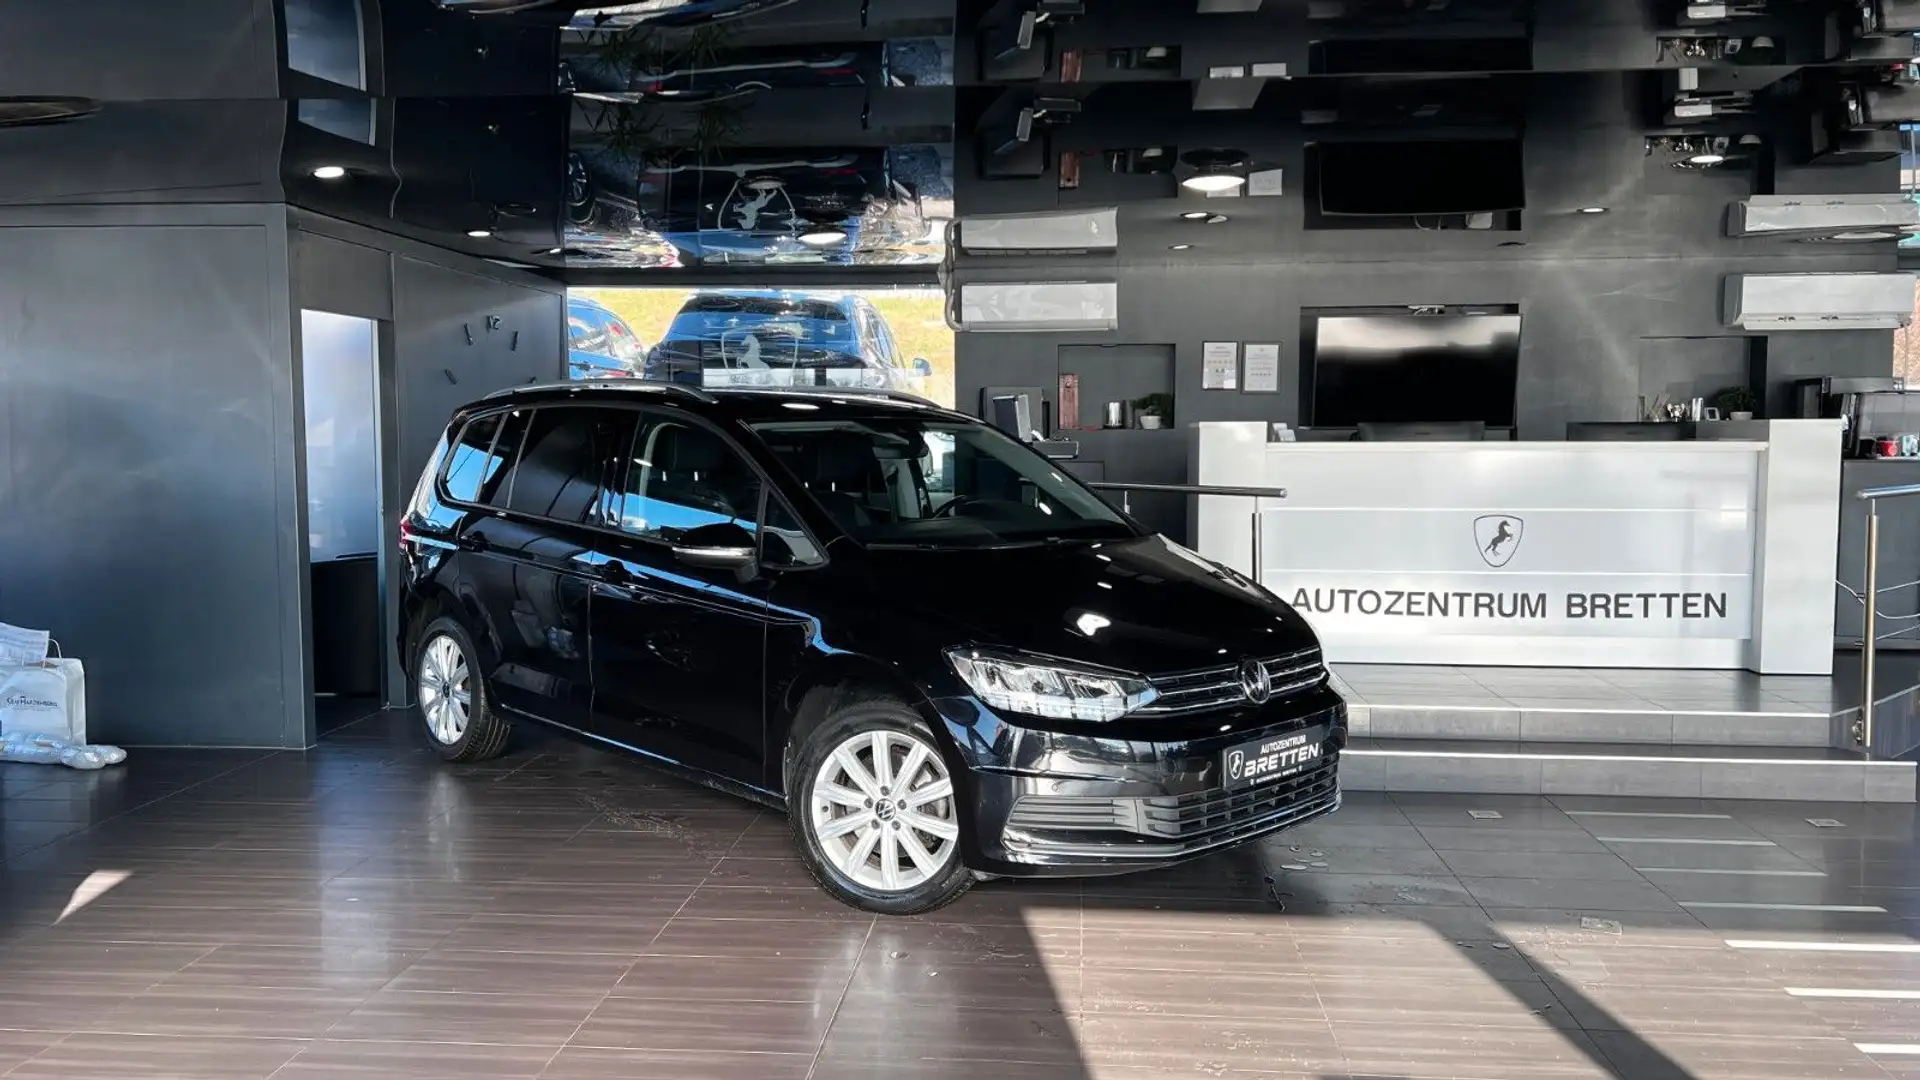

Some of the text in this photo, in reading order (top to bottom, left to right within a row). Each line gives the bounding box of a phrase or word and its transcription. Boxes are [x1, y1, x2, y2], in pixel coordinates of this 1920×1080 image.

[1292, 588, 1727, 618] AUTOZENTRUM BRETTEN
[1260, 734, 1306, 754] AUTOZENTRUM
[1244, 742, 1319, 777] BRETTEN
